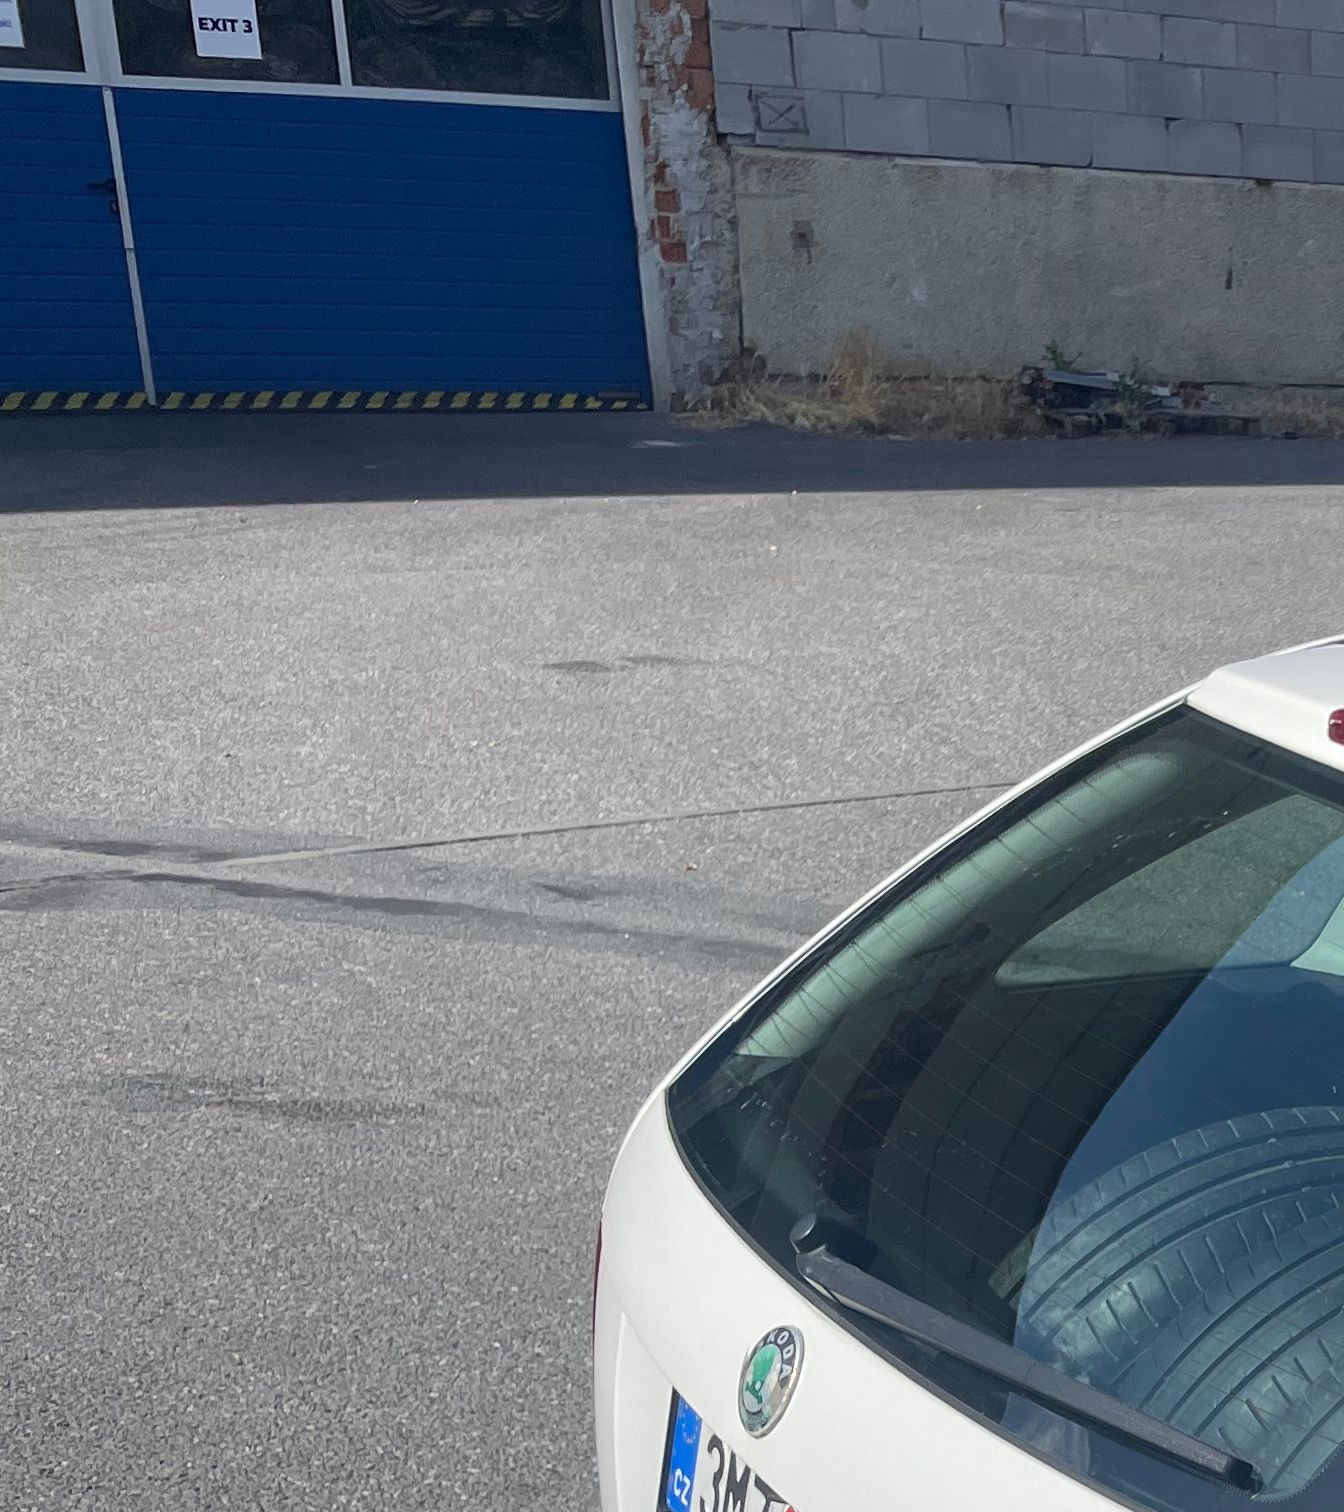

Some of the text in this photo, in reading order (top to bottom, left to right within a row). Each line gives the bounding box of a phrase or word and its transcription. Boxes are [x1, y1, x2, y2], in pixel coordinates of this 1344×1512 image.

[198, 17, 253, 33] EXIT 3
[674, 1467, 691, 1506] CZ
